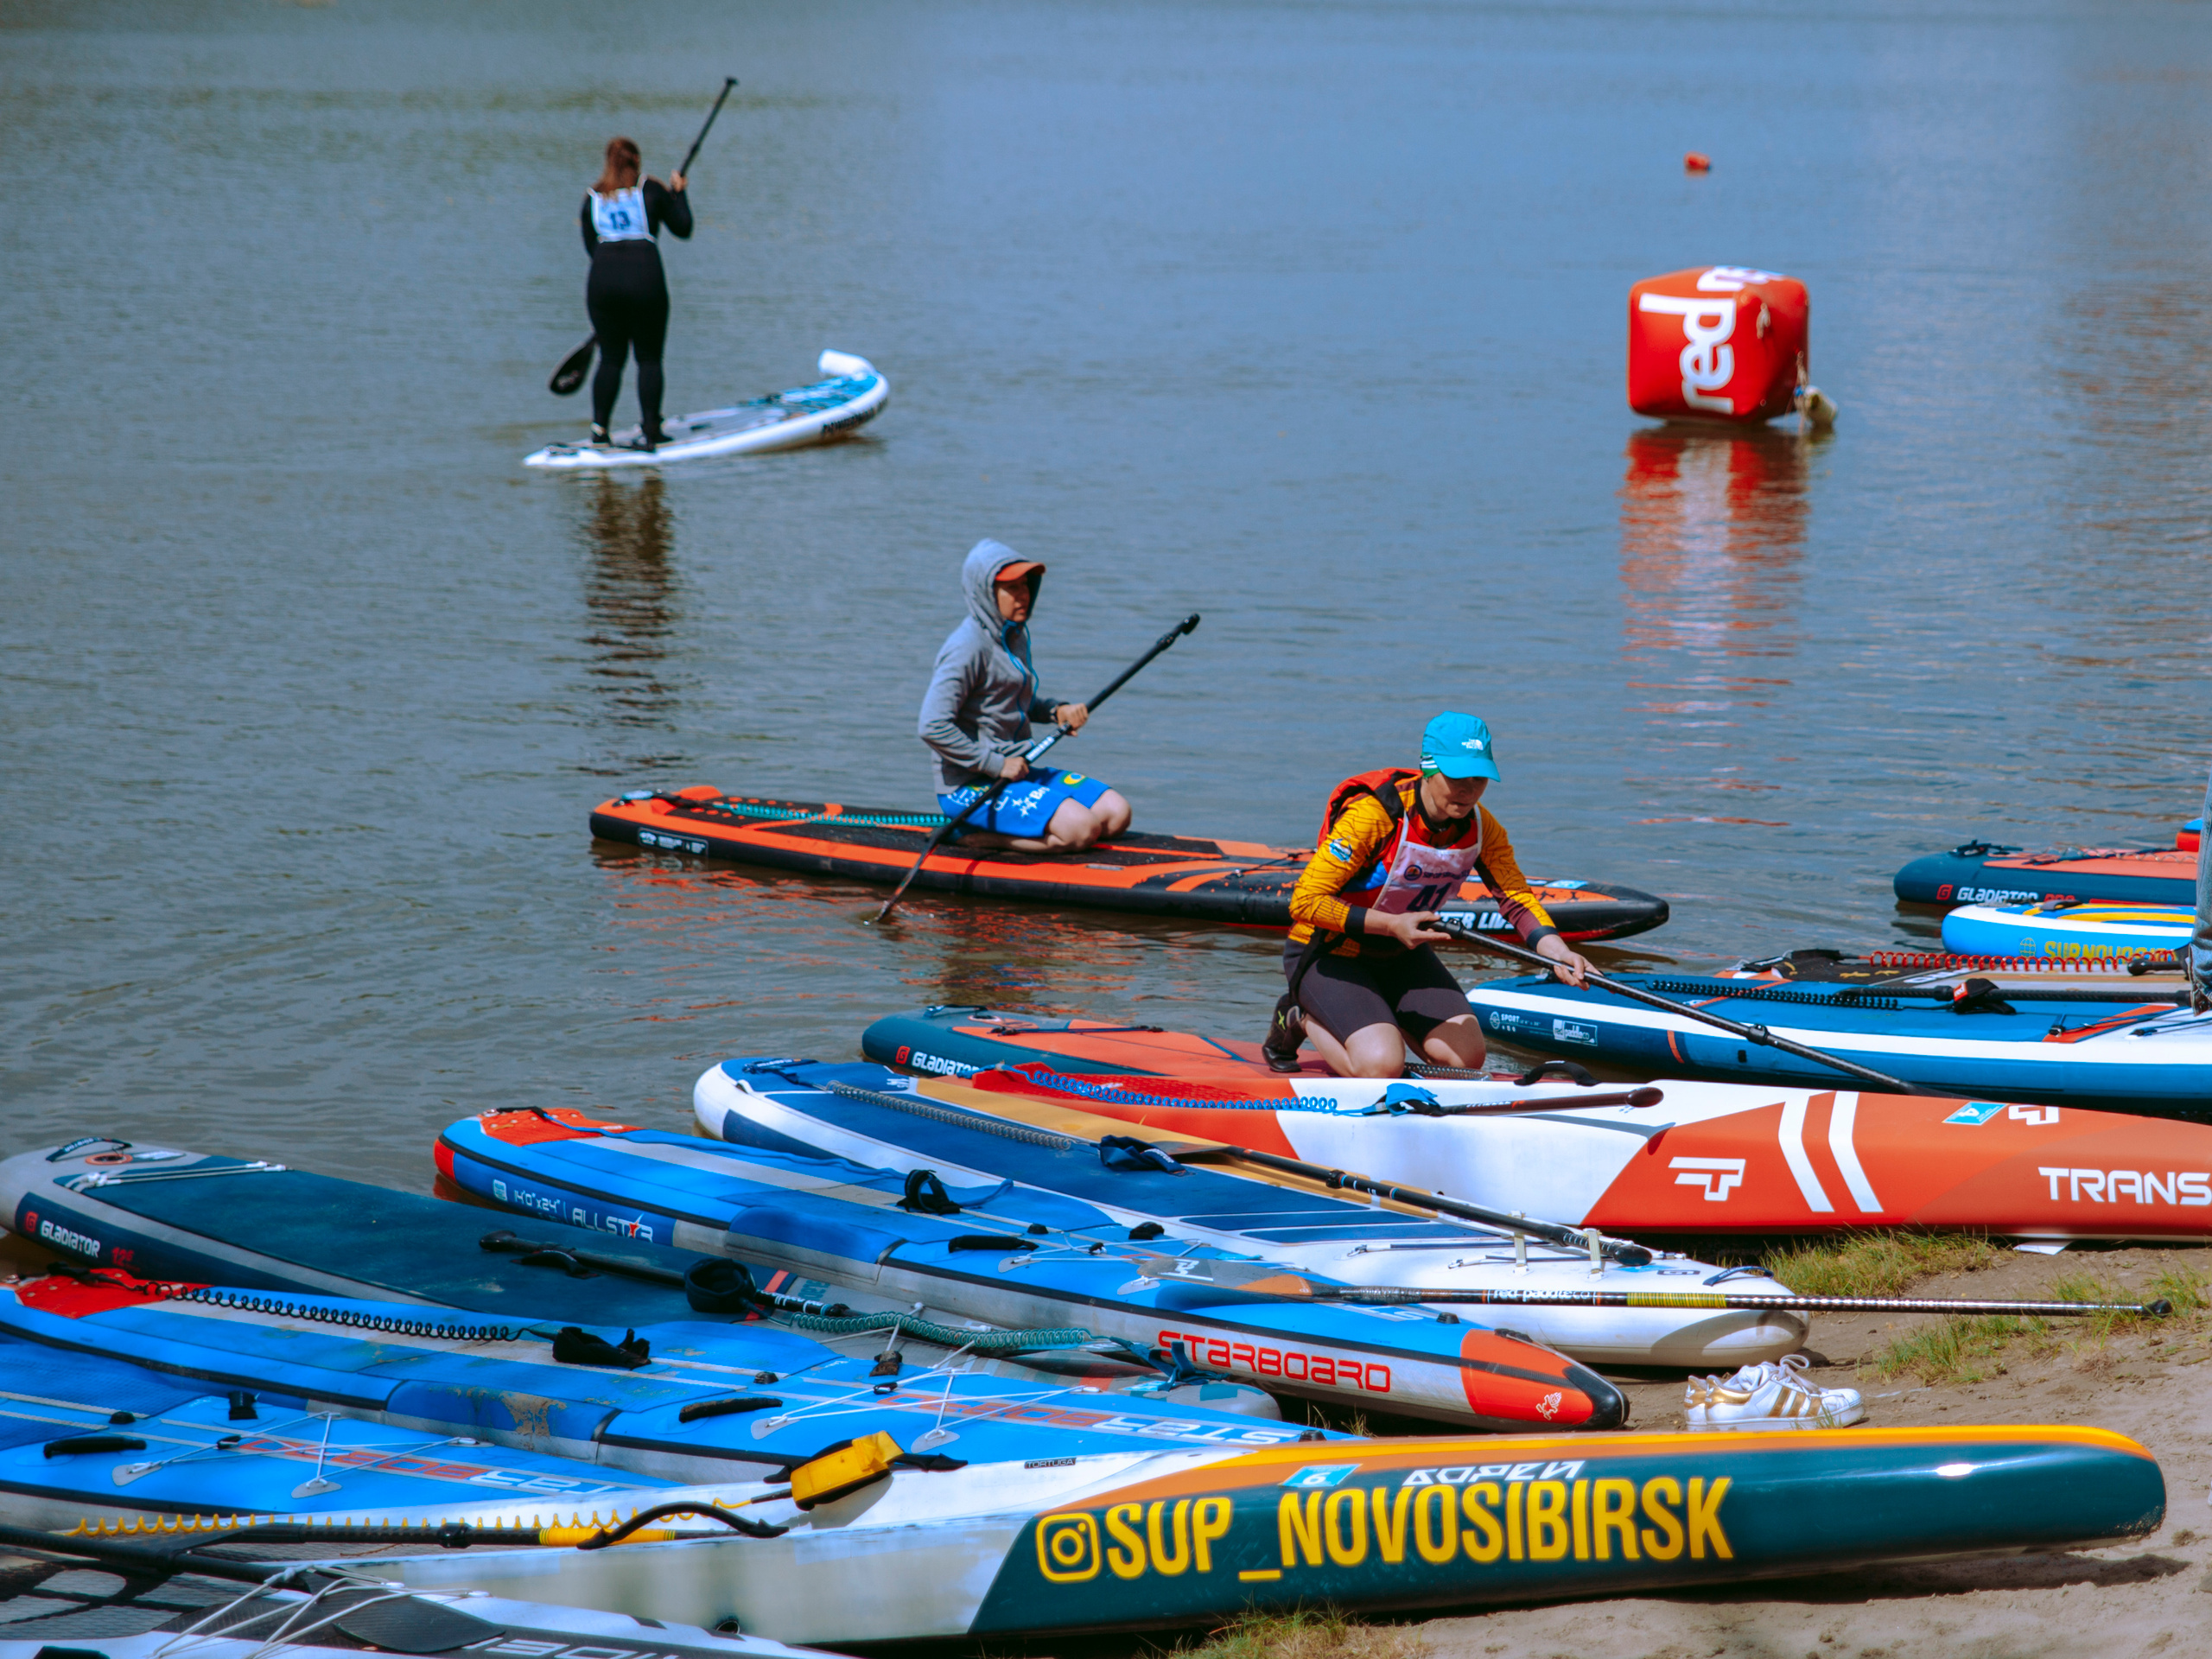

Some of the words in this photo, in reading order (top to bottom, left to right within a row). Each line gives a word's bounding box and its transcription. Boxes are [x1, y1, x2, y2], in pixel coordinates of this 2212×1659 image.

[610, 210, 631, 230] 13
[1638, 292, 1738, 415] red
[1406, 882, 1452, 912] 41
[2037, 1166, 2212, 1206] TRANS
[1027, 1458, 1074, 1469] TORTUGA
[1302, 1471, 1332, 1485] 6
[1105, 1476, 1733, 1583] SUP_NOVOSIBIRSK
